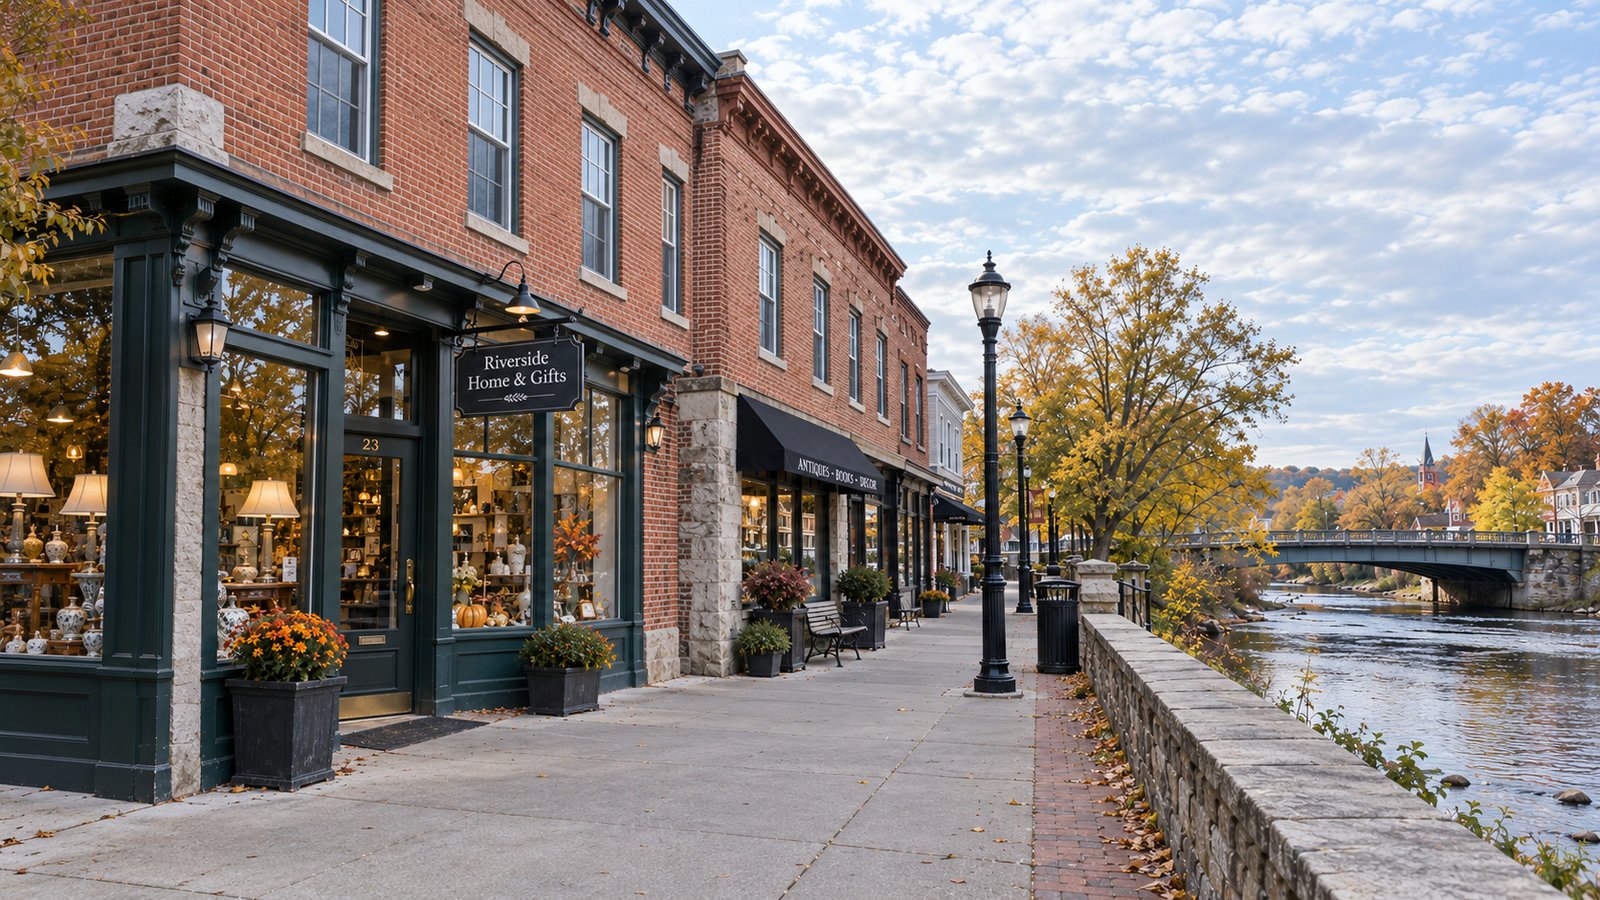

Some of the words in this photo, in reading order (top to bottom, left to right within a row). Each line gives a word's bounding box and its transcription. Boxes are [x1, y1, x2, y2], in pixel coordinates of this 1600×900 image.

[484, 350, 549, 370] Riverside
[468, 375, 510, 390] Home
[514, 372, 526, 386] &
[531, 368, 567, 384] Gifts
[363, 438, 379, 451] 23
[798, 458, 830, 477] ANTIQUES
[836, 469, 854, 484] BOOKS
